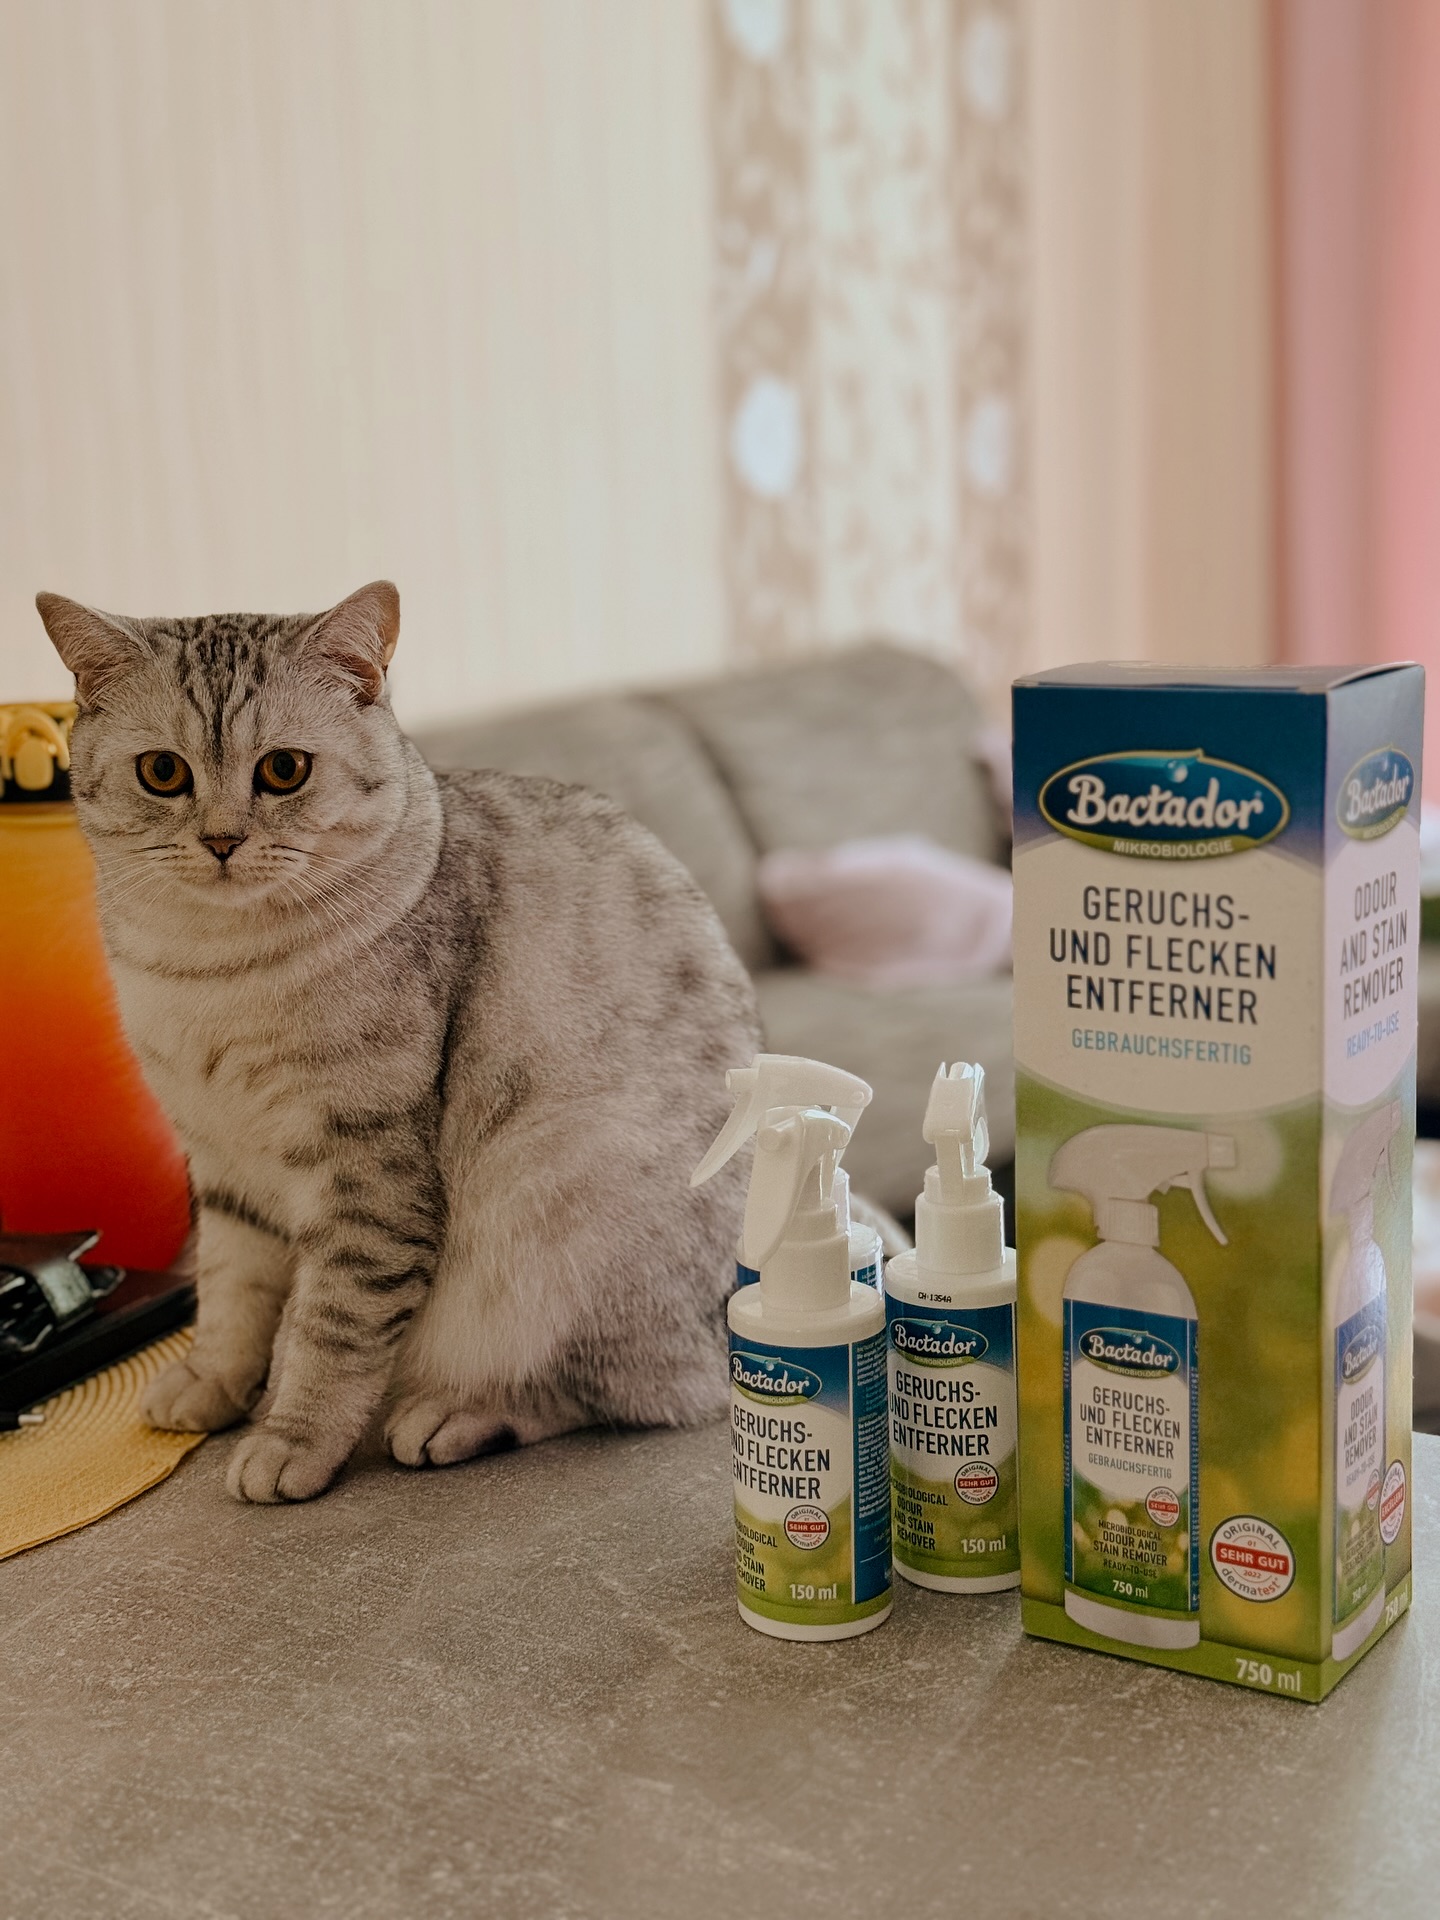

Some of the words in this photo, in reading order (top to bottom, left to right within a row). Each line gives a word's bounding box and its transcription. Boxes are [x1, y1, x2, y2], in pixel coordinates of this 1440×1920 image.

[1067, 774, 1264, 830] Bactador
[1346, 765, 1410, 822] Bactador
[1113, 840, 1234, 858] MIKROBIOLOGIE
[1083, 885, 1250, 930] GERUCHS-
[1354, 871, 1397, 922] ODOUR
[1050, 927, 1111, 966] UND
[1126, 934, 1276, 980] FLECKEN
[1340, 930, 1367, 976] AND
[1372, 909, 1407, 959] STAIN
[1067, 974, 1258, 1025] ENTFERNER
[1343, 956, 1404, 1020] REMOVER
[1072, 1028, 1252, 1065] GEBRAUCHSFERTIG
[1346, 1011, 1400, 1059] READY-TO-USE
[895, 1323, 976, 1355] Bactador
[1089, 1335, 1173, 1367] Bactador
[732, 1357, 810, 1393] Bactador
[896, 1370, 980, 1403] GERUCHS-
[890, 1390, 909, 1420] UND
[913, 1402, 997, 1430] FLECKEN
[1093, 1386, 1170, 1416] GERUCHS-
[1351, 1386, 1374, 1420] ODOUR
[733, 1404, 812, 1444] GERUCHS-
[893, 1419, 990, 1456] ENTFERNER
[1080, 1403, 1105, 1425] UND
[1113, 1411, 1180, 1439] FLECKEN
[1344, 1424, 1358, 1448] AND
[1359, 1402, 1378, 1432] STAIN
[748, 1439, 830, 1471] FLECKEN
[1086, 1426, 1174, 1459] ENTFERNER
[1345, 1429, 1377, 1468] REMOVER
[732, 1455, 821, 1499] ENTFERNER
[959, 1479, 978, 1487] SEHR
[979, 1478, 994, 1486] GUT
[961, 1465, 991, 1477] ORIGINAL
[1088, 1453, 1172, 1479] GEBRAUCHSFERTIG
[790, 1508, 822, 1519] ORIGINAL
[908, 1516, 934, 1535] STAIN
[1098, 1520, 1162, 1540] MICROBIOLOGICAL
[961, 1539, 985, 1554] 150
[989, 1535, 1006, 1552] ml
[1103, 1531, 1135, 1547] ODOUR
[1138, 1539, 1157, 1552] AND
[1223, 1523, 1281, 1549] ORIGINAL
[743, 1554, 765, 1576] STAIN
[1093, 1540, 1119, 1557] STAIN
[1122, 1547, 1167, 1566] REMOVER
[1103, 1559, 1157, 1578] READY-TO-USE
[1220, 1547, 1254, 1564] SEHR
[1258, 1556, 1285, 1570] GUT
[1112, 1580, 1133, 1595] 750
[1135, 1585, 1148, 1598] ml
[1243, 1570, 1262, 1578] 2022
[789, 1583, 815, 1600] 150
[818, 1583, 837, 1599] ml
[1236, 1658, 1272, 1686] 750
[1278, 1670, 1300, 1692] ml
